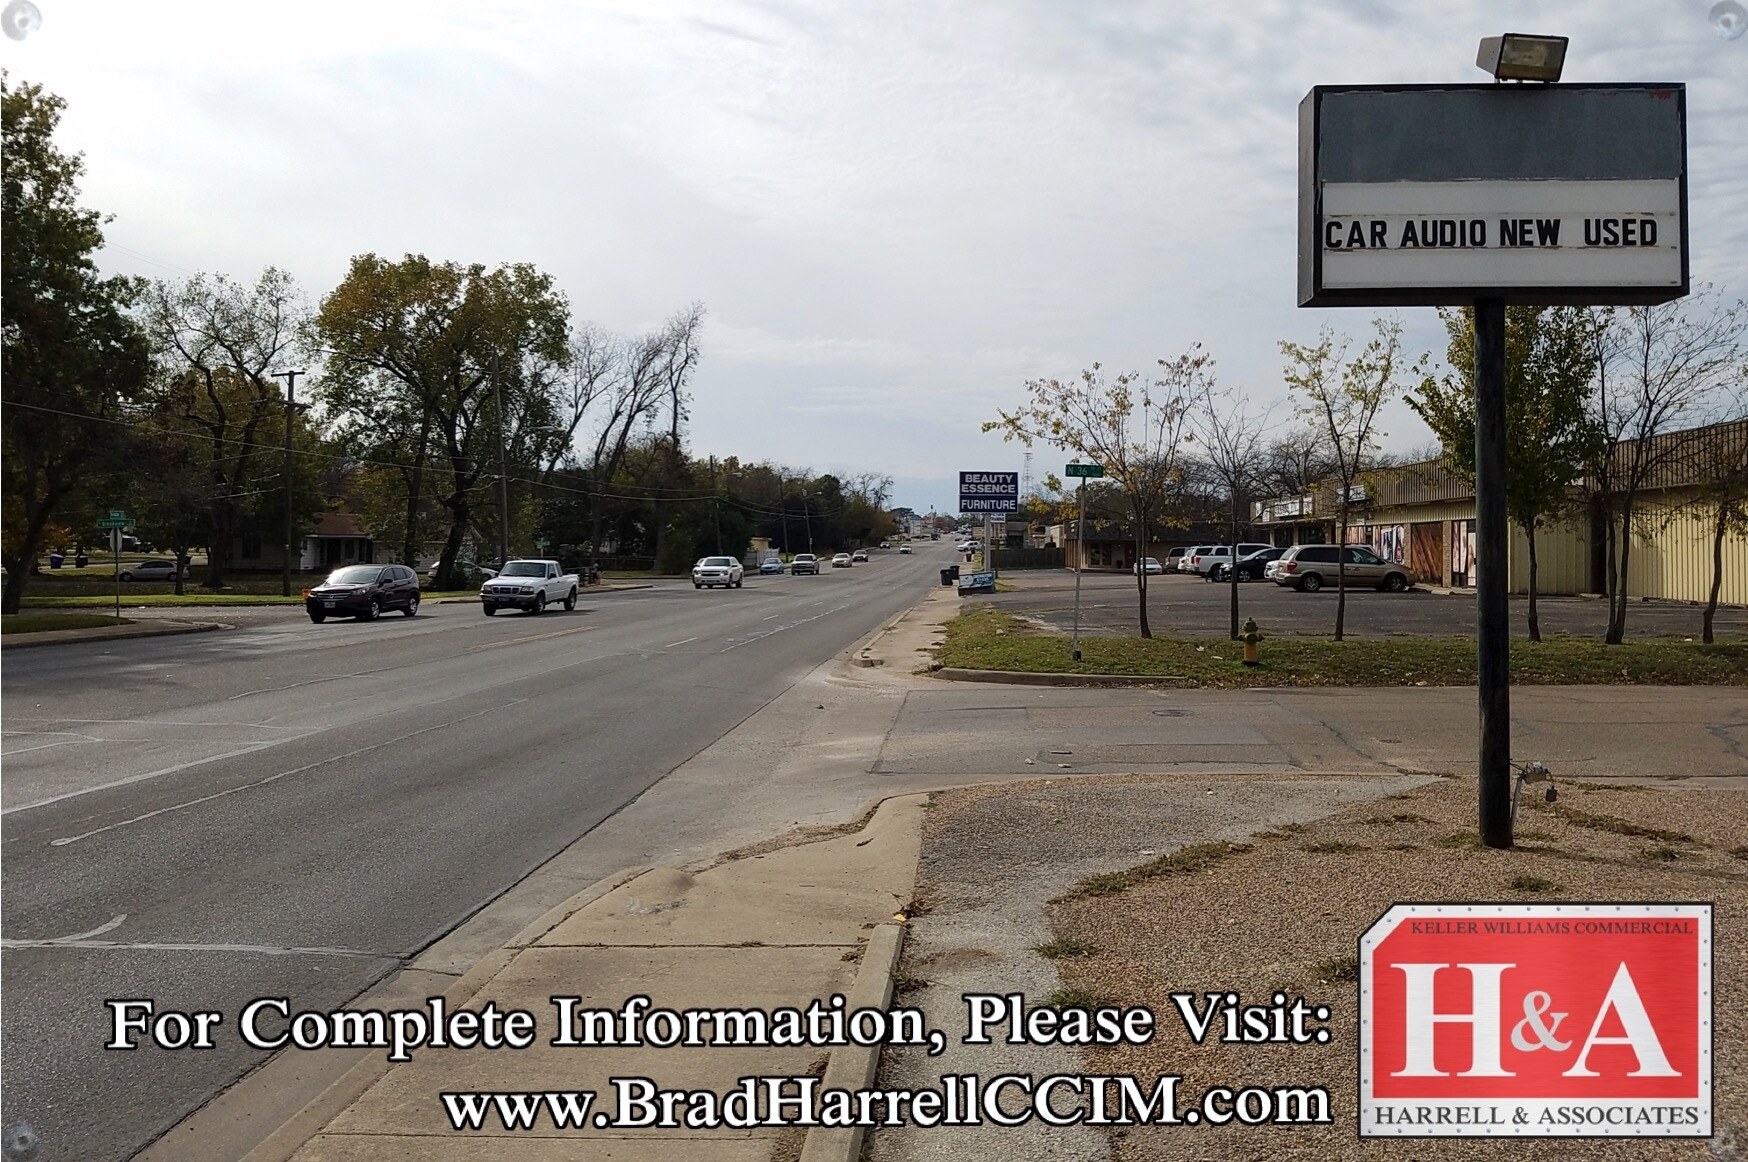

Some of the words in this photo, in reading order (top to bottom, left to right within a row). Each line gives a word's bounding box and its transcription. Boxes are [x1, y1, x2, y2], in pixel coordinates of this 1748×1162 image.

[1325, 220, 1387, 249] CAR
[1400, 219, 1486, 248] AUDIO
[1500, 219, 1561, 247] NEW
[1584, 218, 1658, 247] USED
[1067, 466, 1074, 475] N
[1076, 466, 1087, 475] 36
[965, 474, 1014, 483] BEAUTY
[961, 484, 1016, 493] ESSENCE
[961, 499, 1016, 509] FURNITURE
